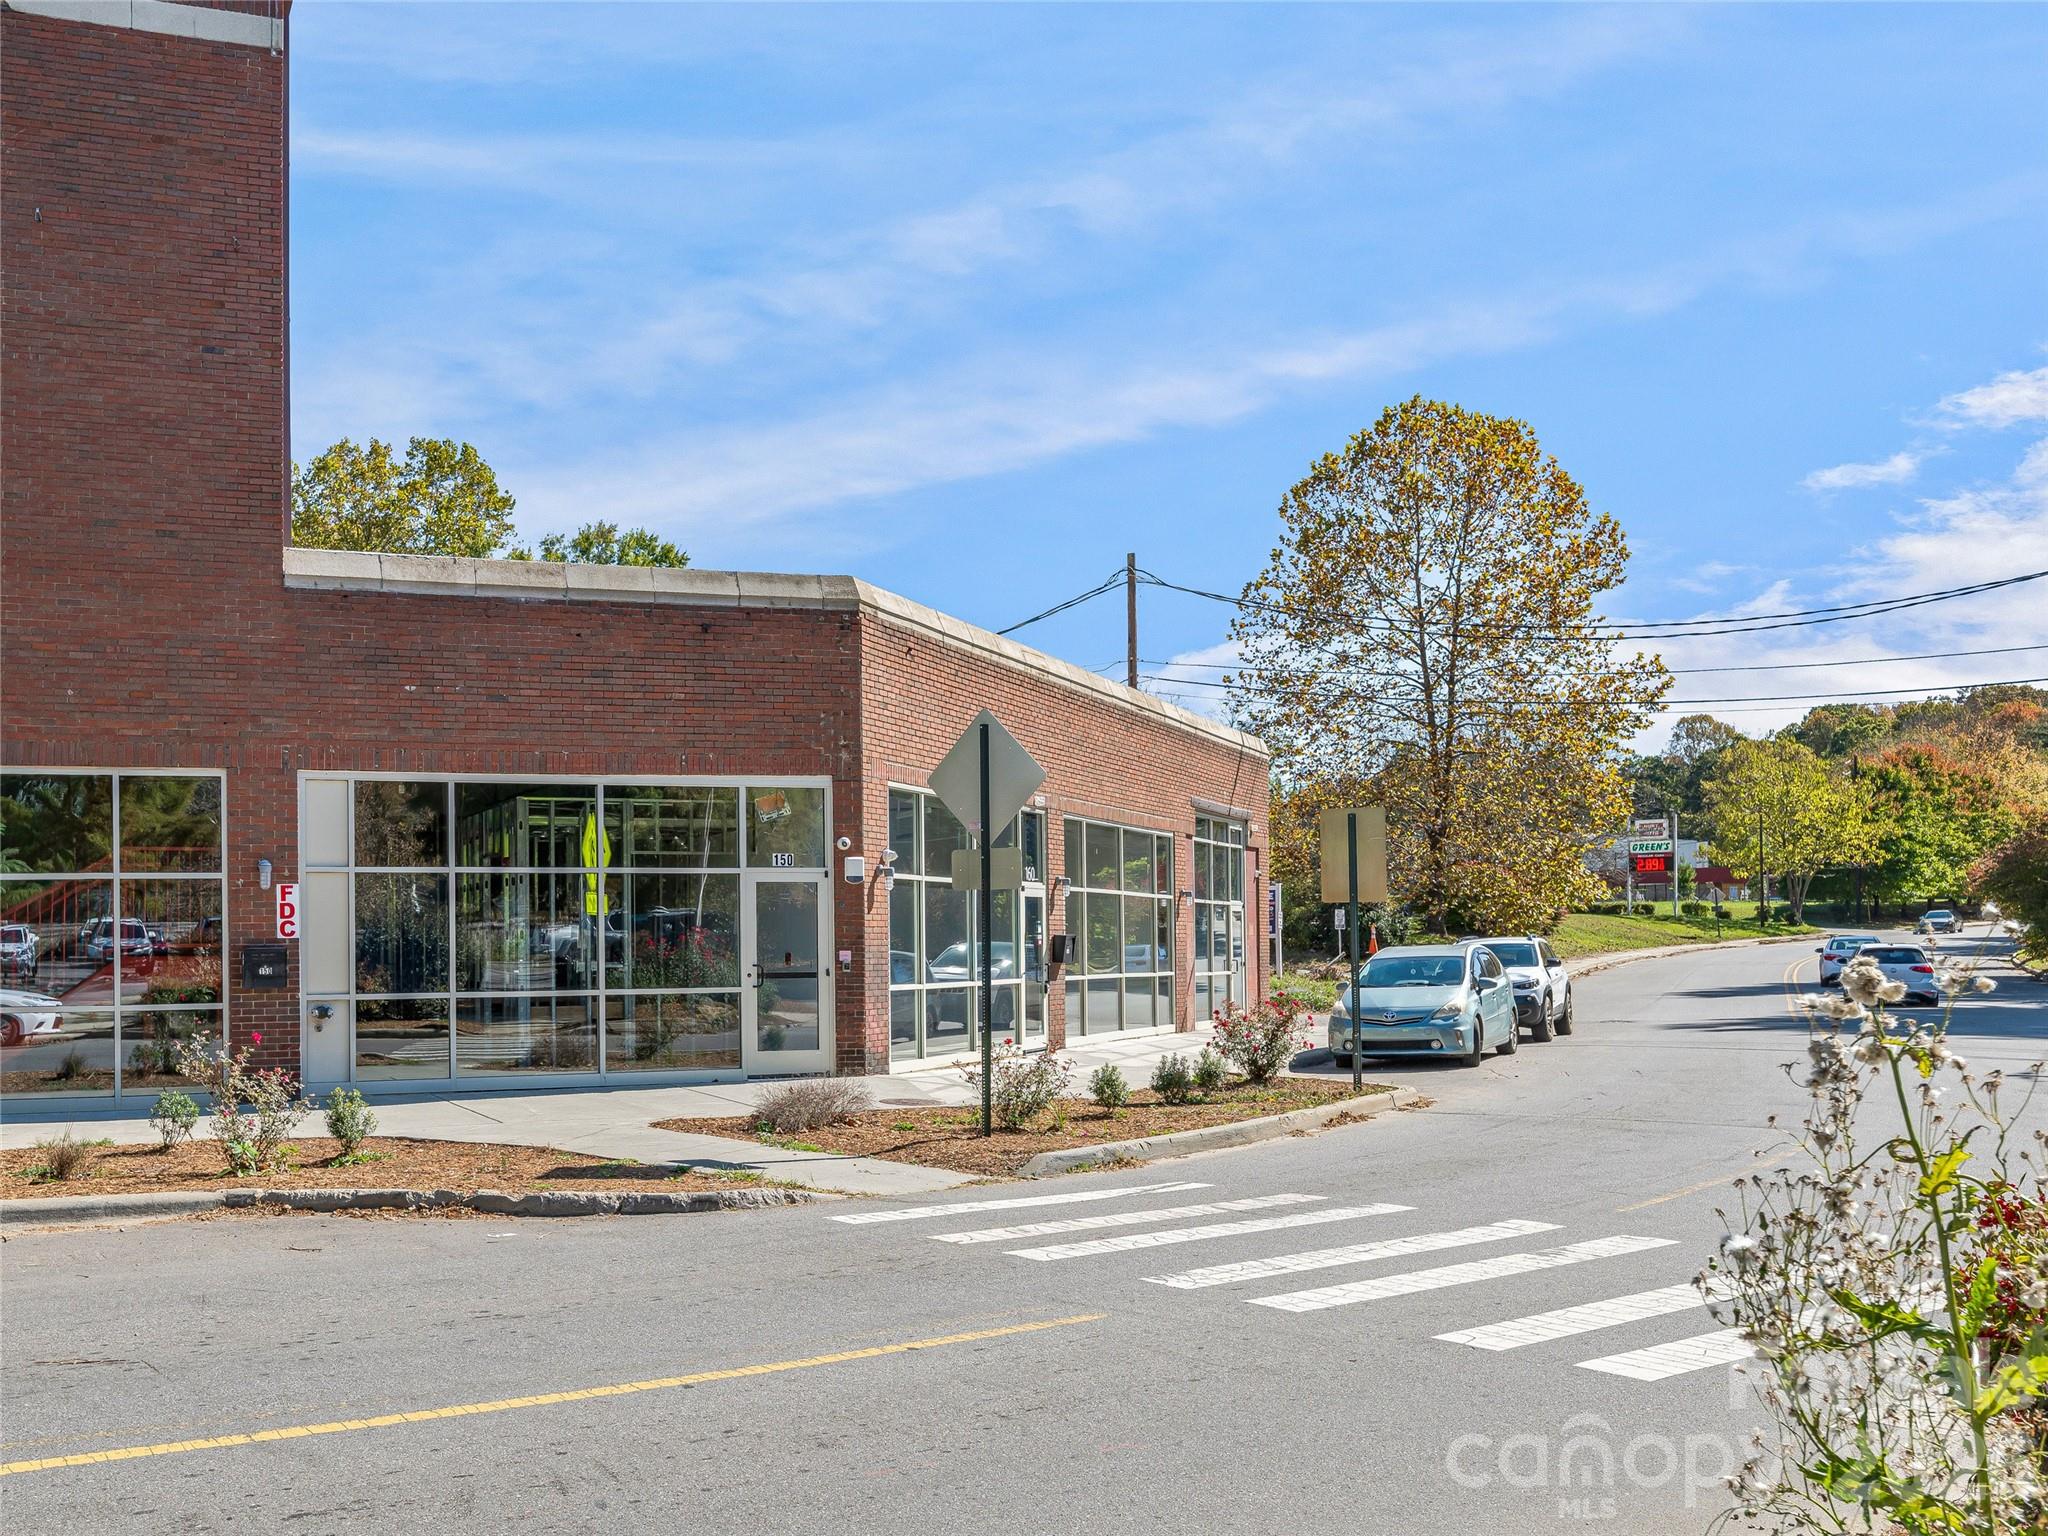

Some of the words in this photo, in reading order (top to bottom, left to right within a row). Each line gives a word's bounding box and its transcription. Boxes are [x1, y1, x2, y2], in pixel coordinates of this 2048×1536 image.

[1632, 843, 1670, 852] GREEN'S
[774, 854, 793, 866] 150
[279, 885, 296, 938] FDC
